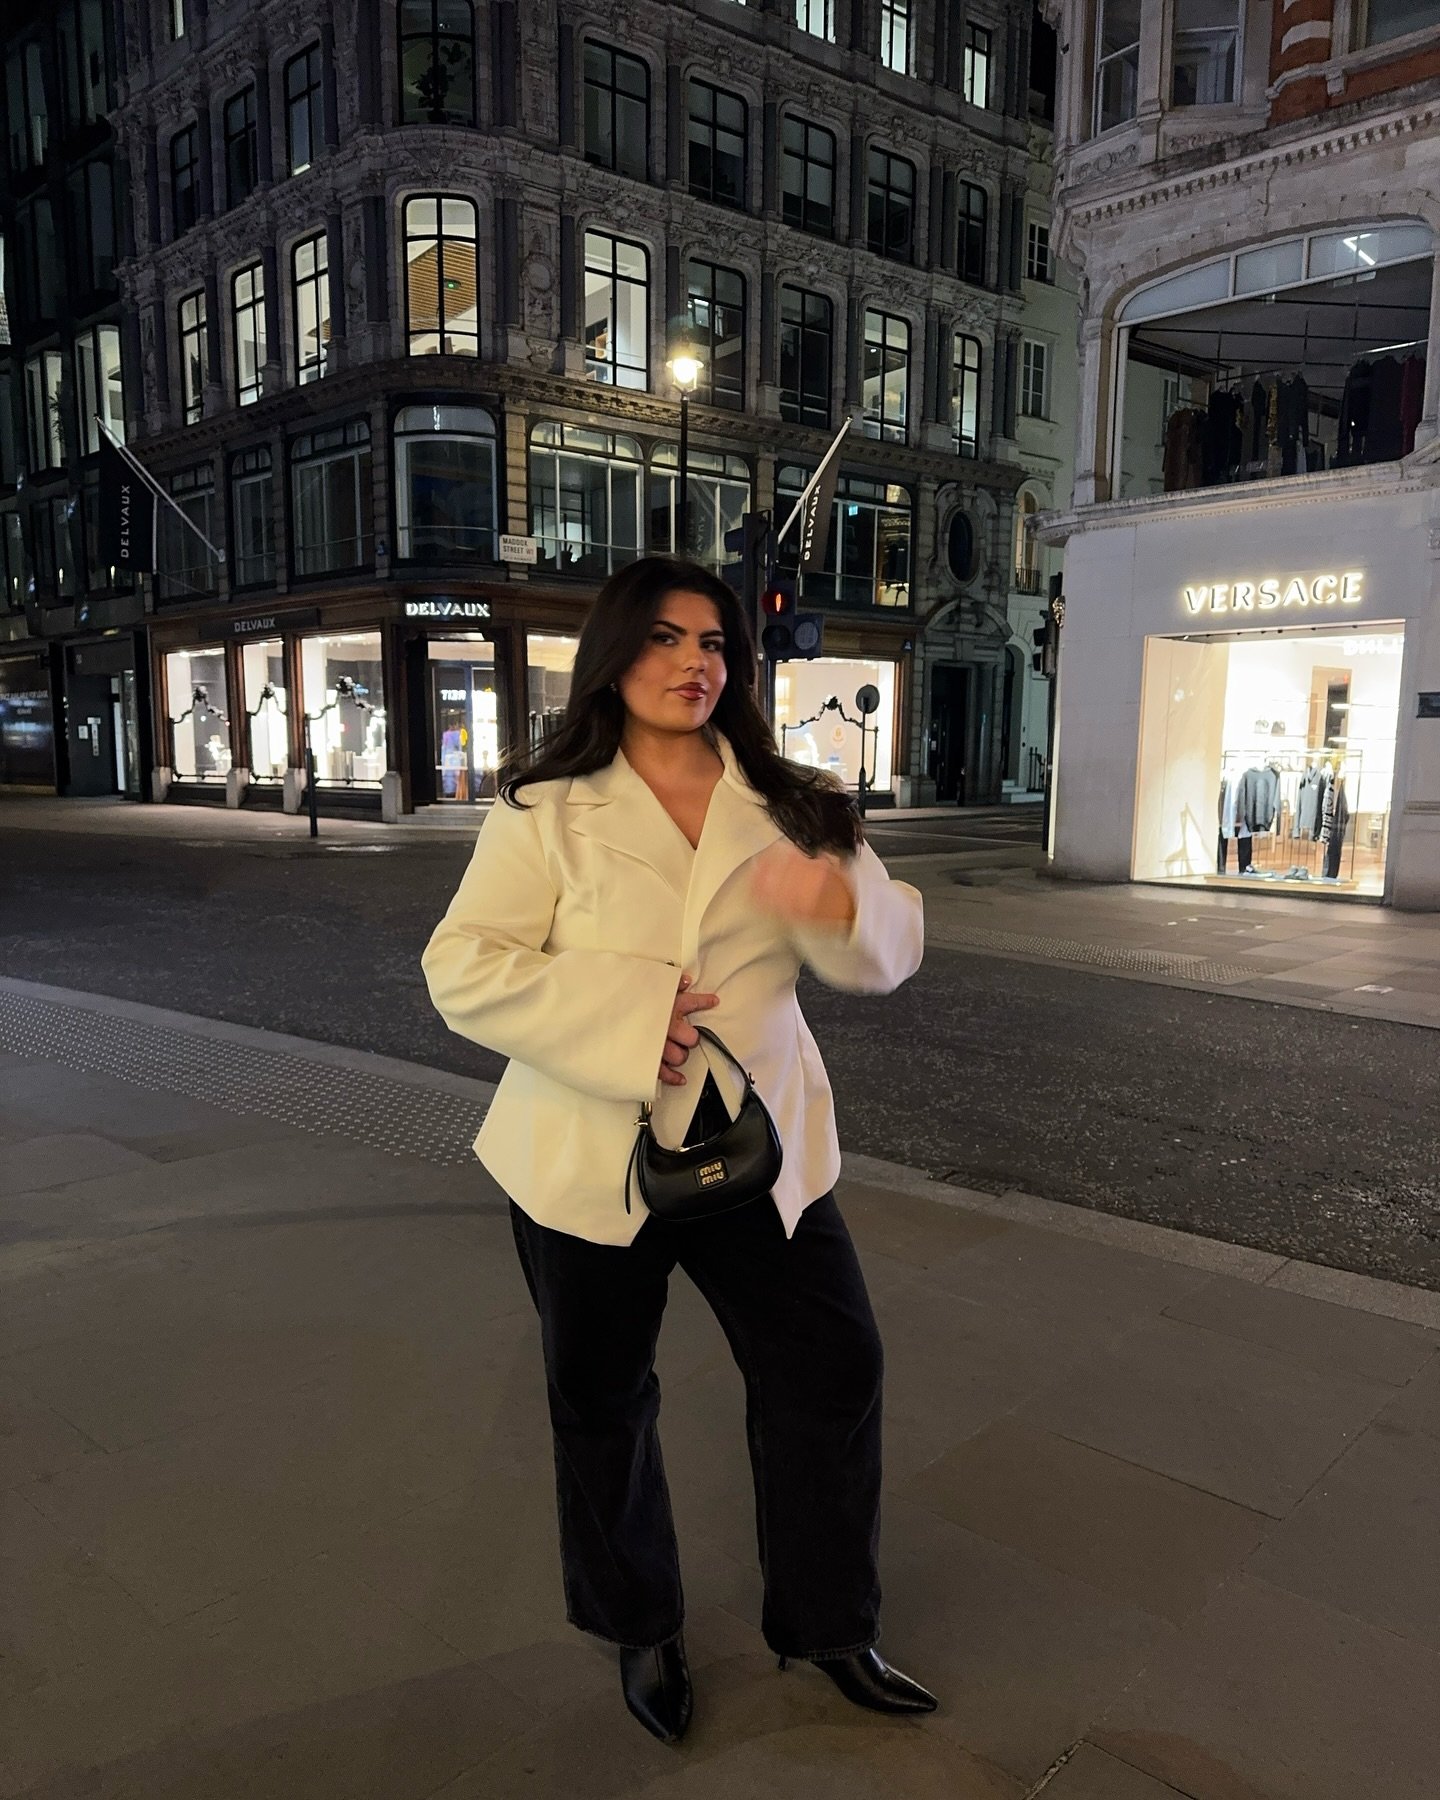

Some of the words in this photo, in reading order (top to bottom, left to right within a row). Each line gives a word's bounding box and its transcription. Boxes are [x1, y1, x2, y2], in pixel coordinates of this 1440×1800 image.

[121, 485, 131, 558] DELVAUX
[804, 485, 821, 561] DELVAUX
[503, 545, 524, 554] STREET
[1184, 571, 1364, 614] VERSACE
[405, 601, 491, 617] DELVAUX
[234, 617, 276, 632] DELVAUX
